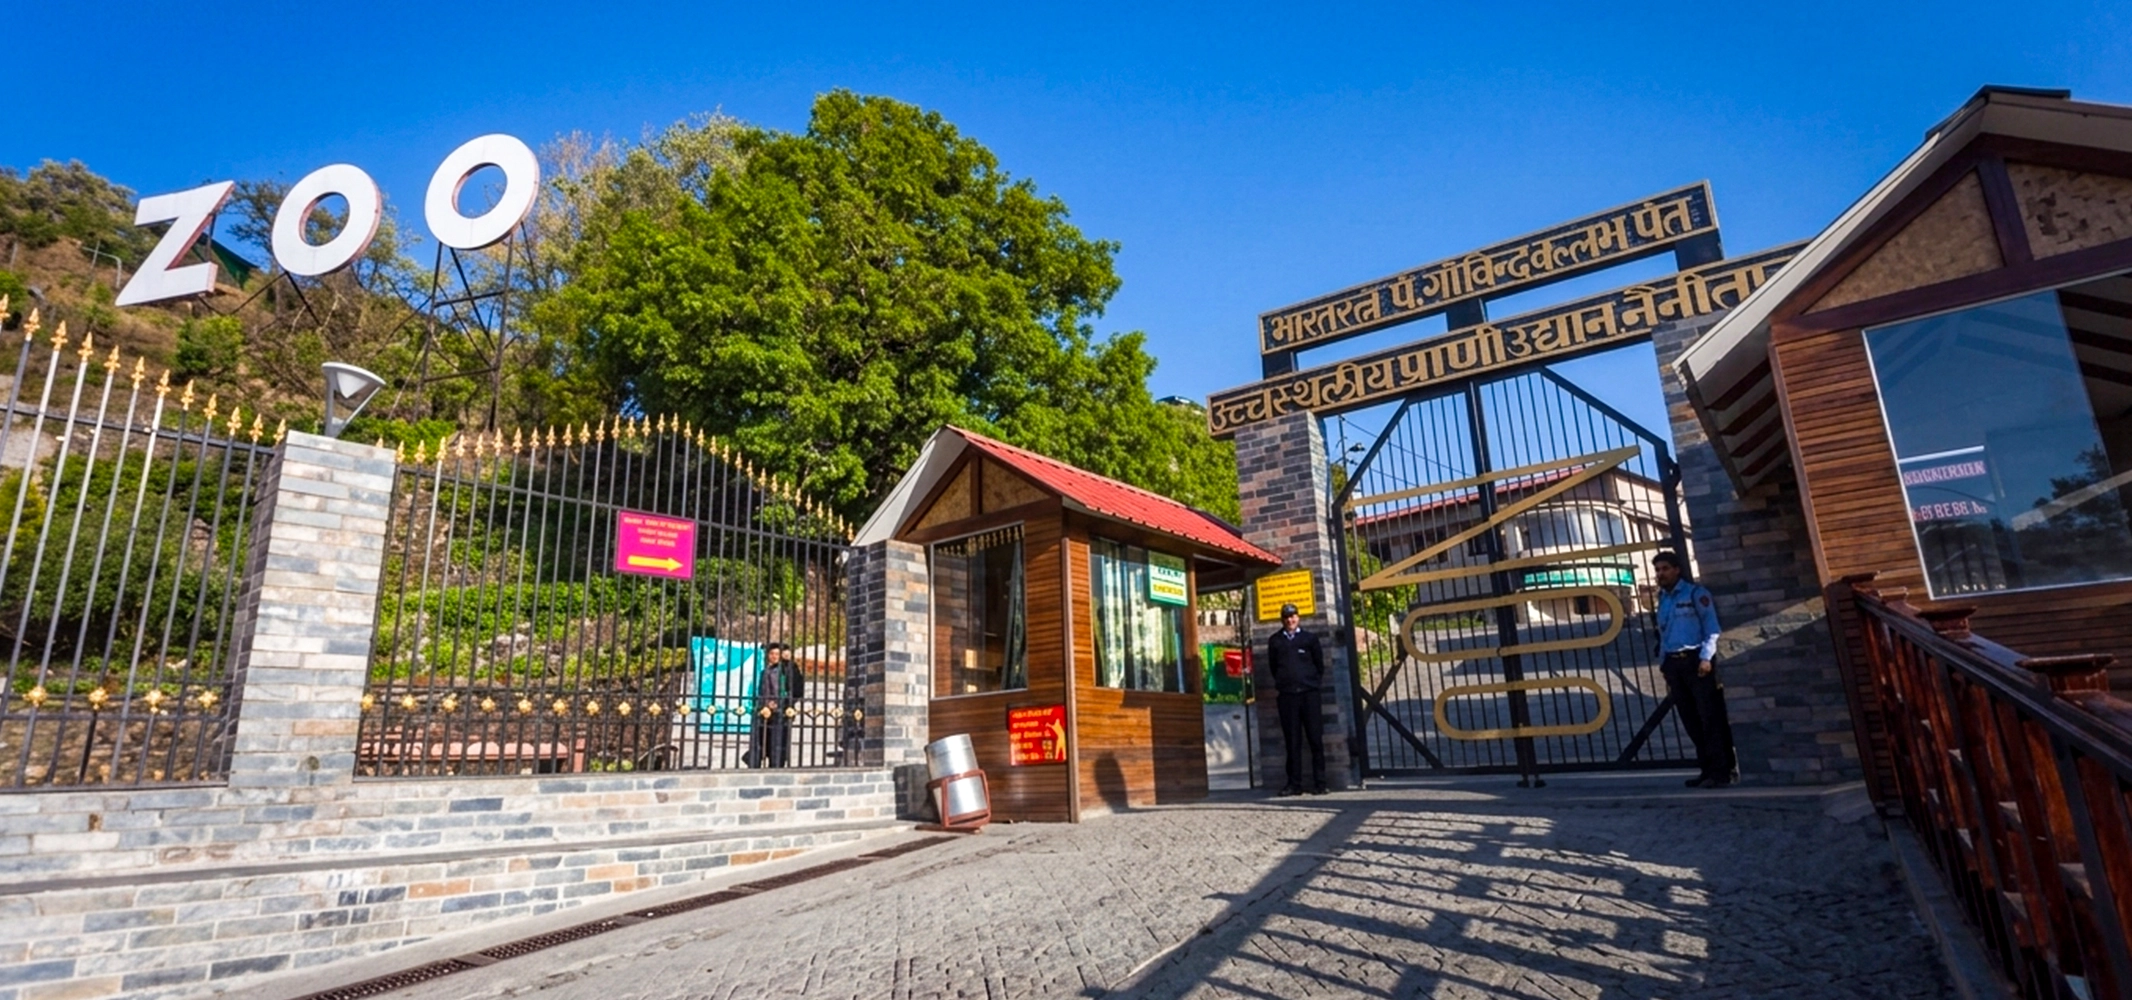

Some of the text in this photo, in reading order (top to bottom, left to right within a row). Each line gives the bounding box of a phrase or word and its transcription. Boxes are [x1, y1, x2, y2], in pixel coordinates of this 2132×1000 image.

[115, 133, 540, 307] ZOO
[1632, 195, 1693, 241] पंत
[1621, 254, 1788, 327] नैनीता
